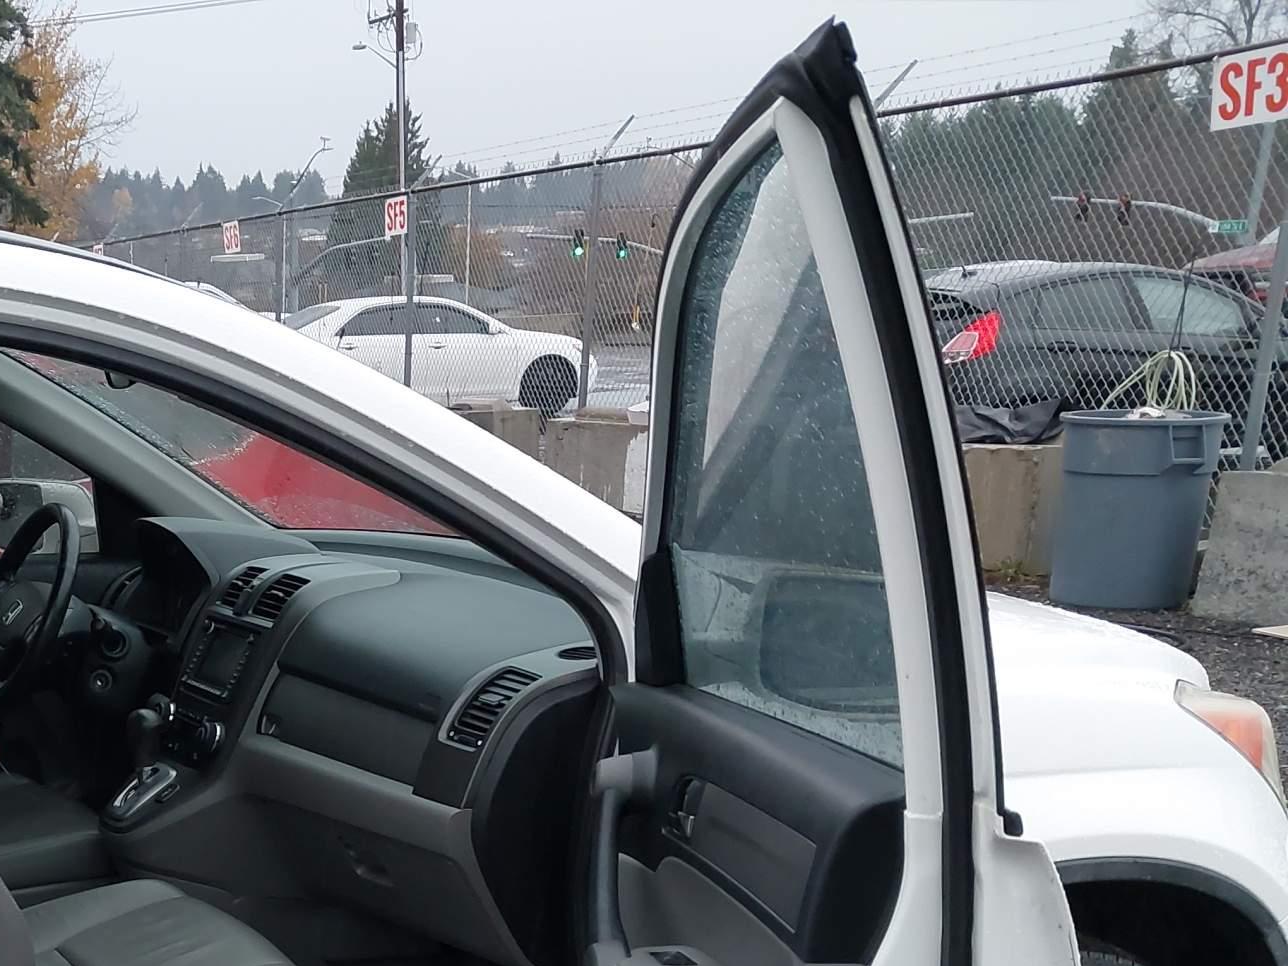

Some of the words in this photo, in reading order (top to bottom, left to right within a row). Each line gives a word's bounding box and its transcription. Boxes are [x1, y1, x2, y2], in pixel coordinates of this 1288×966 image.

[1218, 52, 1288, 121] SF3
[386, 200, 406, 232] SF5
[224, 224, 239, 250] SF6
